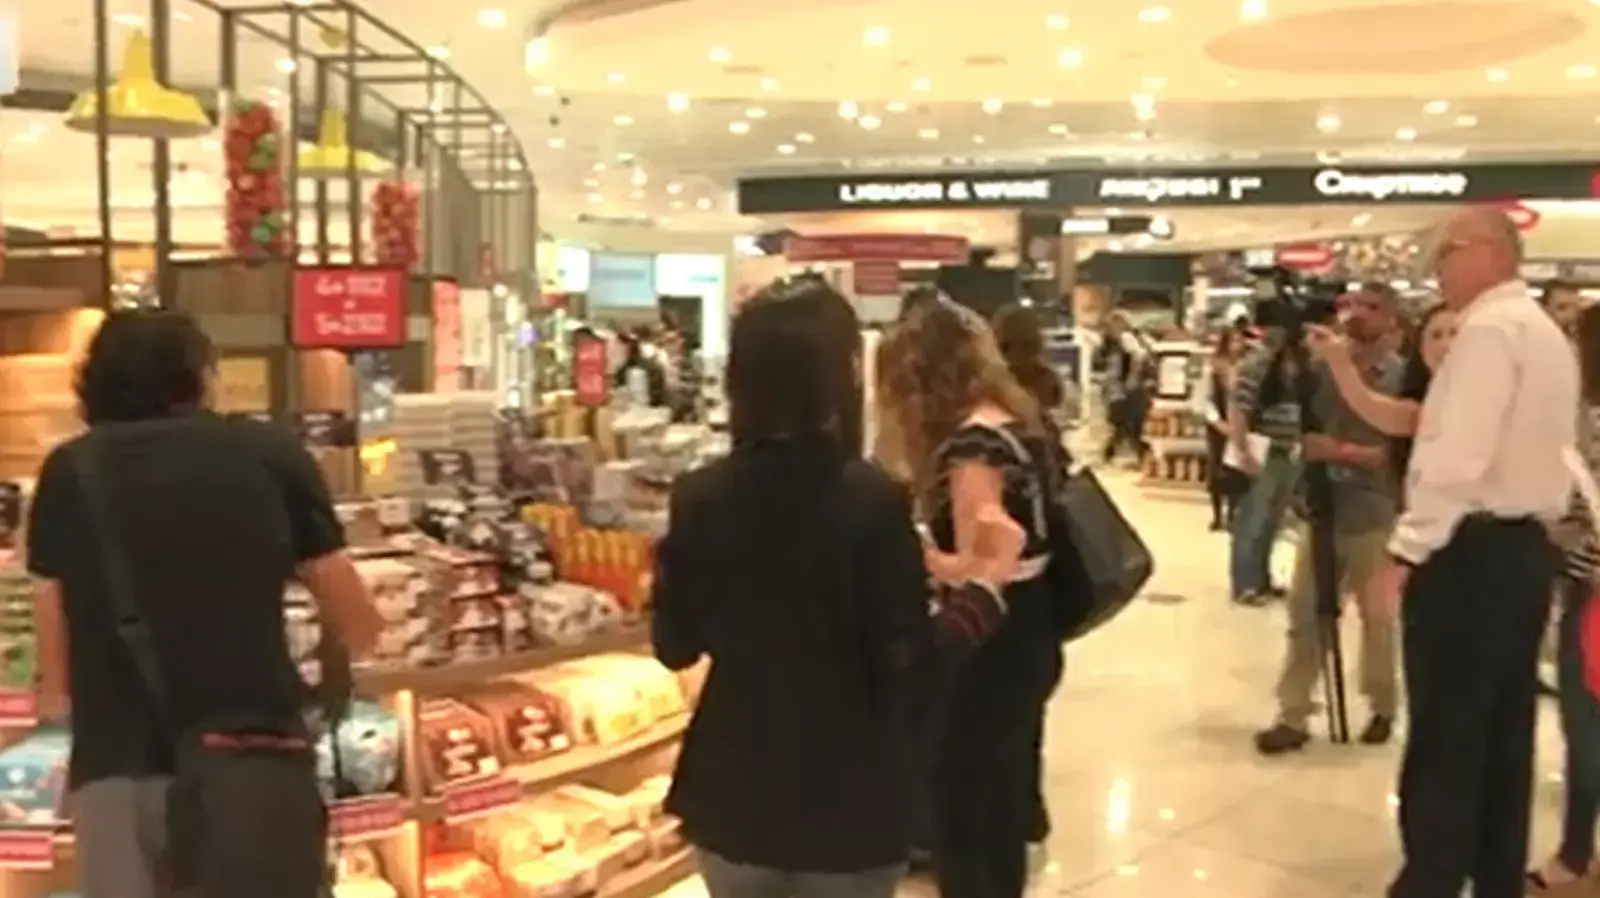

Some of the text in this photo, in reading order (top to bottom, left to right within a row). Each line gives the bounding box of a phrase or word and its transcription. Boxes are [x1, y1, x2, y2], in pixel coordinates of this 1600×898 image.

[839, 178, 1050, 202] LIQUOR & WINE
